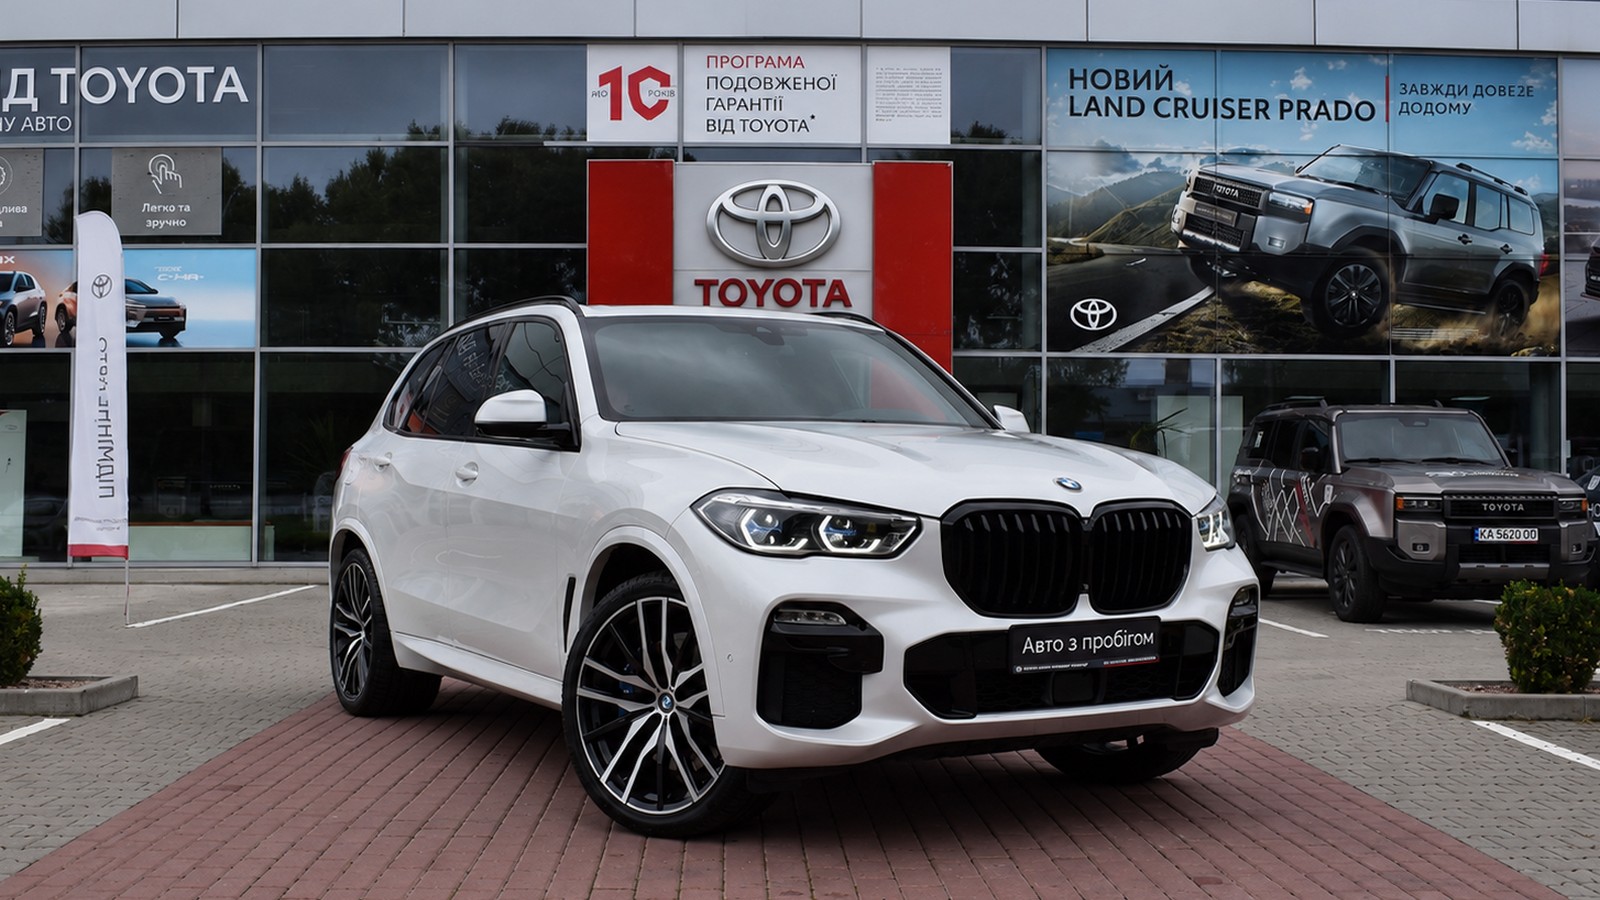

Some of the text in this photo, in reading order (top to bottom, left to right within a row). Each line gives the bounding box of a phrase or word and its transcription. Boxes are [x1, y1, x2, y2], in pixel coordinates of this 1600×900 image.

[706, 55, 805, 69] ПРОГРАМА
[50, 66, 249, 104] TOYOTA
[706, 74, 838, 93] ПОДОВЖЕНОЇ
[1069, 64, 1173, 91] НОВИЙ
[1399, 83, 1468, 98] ЗАВЖДИ
[706, 95, 784, 111] ГАРАНТІЇ
[1069, 96, 1376, 122] LAND CRUISER PRADO
[1399, 102, 1472, 116] ДОДОМУ
[20, 115, 72, 132] АВТО
[706, 119, 735, 135] ВІД
[0, 205, 28, 215] лива
[141, 203, 191, 213] Легко та
[145, 219, 187, 230] зручно
[694, 278, 853, 308] TOYOTA
[1482, 503, 1525, 512] TOYOTA
[1479, 529, 1494, 540] KA
[1496, 529, 1521, 540] 5620
[1022, 629, 1155, 654] Авто з пробігом
